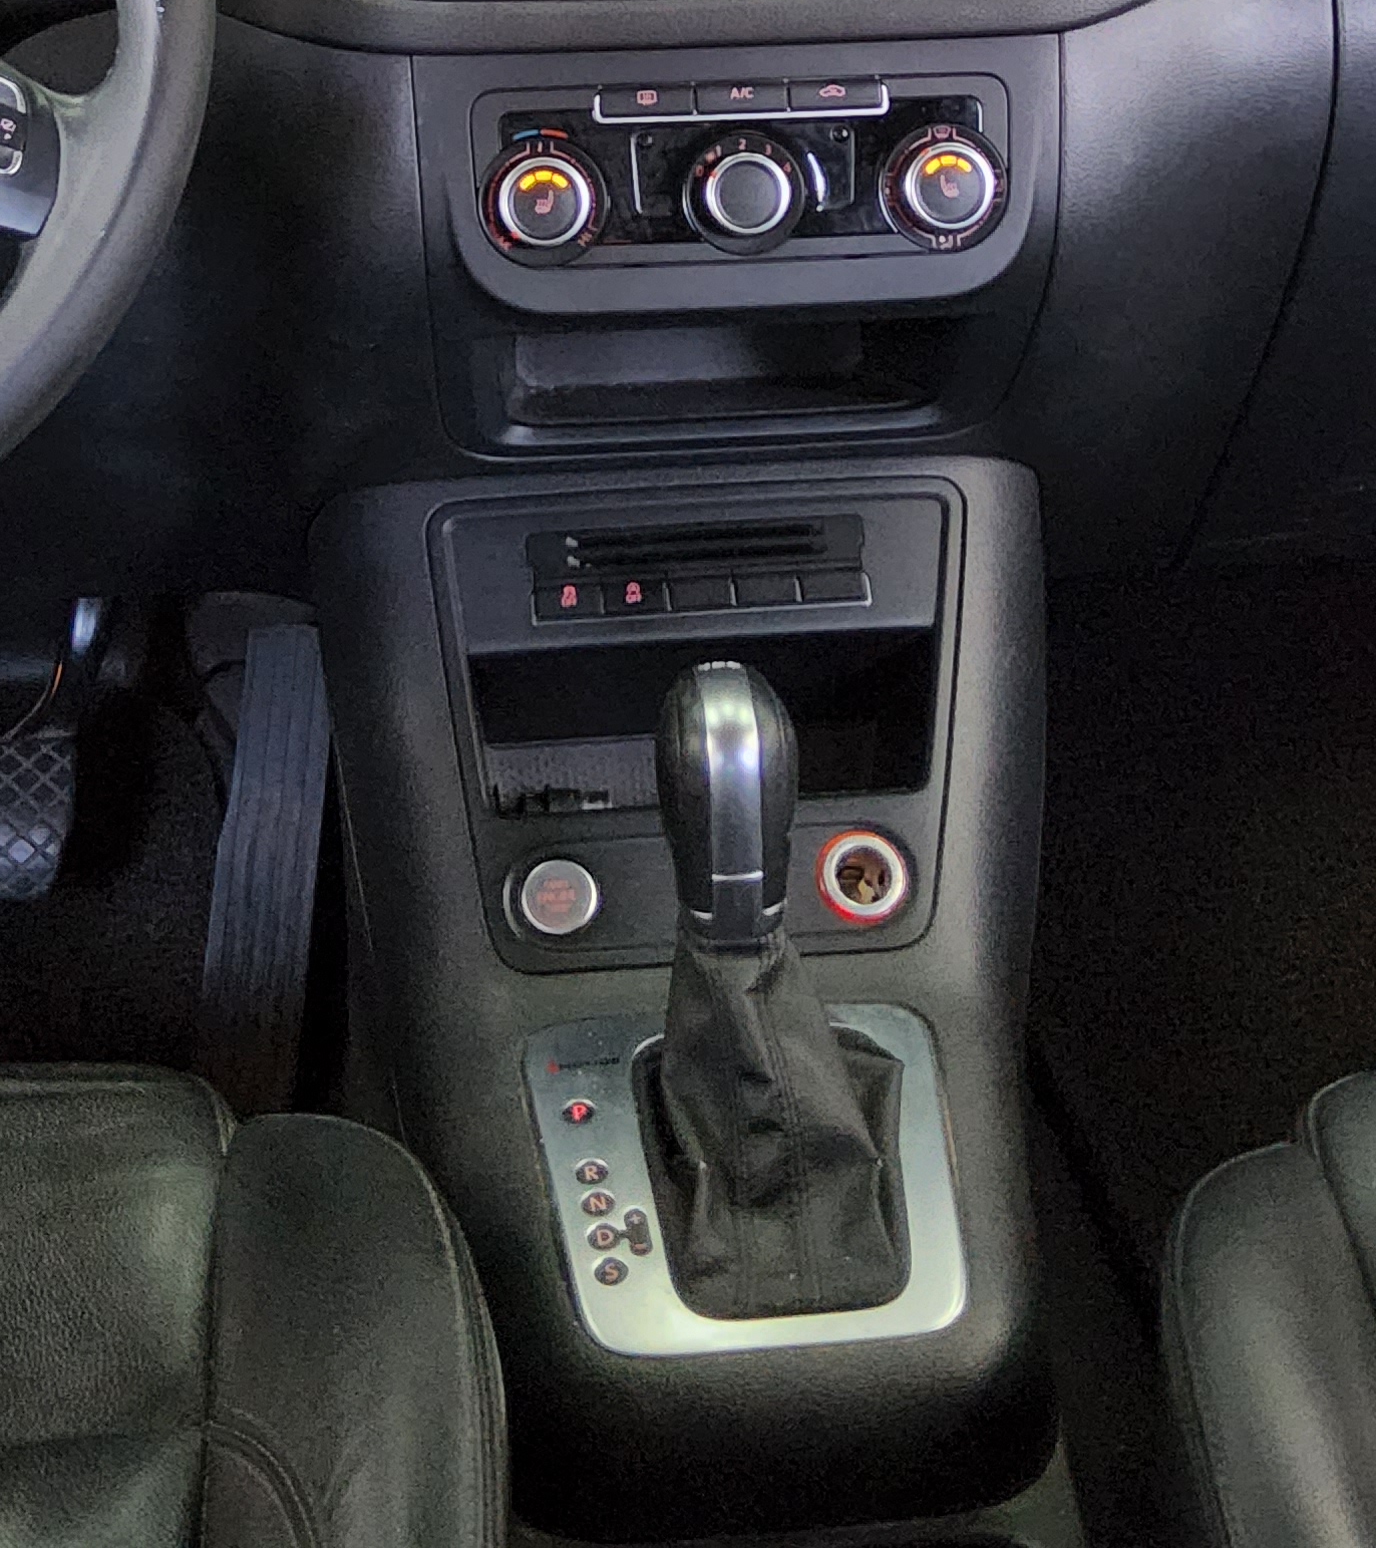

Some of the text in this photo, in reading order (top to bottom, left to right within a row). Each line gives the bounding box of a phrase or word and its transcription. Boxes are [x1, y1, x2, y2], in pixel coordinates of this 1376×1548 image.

[730, 86, 755, 100] A/C
[739, 138, 747, 151] 2
[573, 1105, 588, 1121] P
[584, 1166, 599, 1181] R
[589, 1196, 607, 1211] N
[596, 1228, 614, 1244] D
[603, 1262, 619, 1282] S
